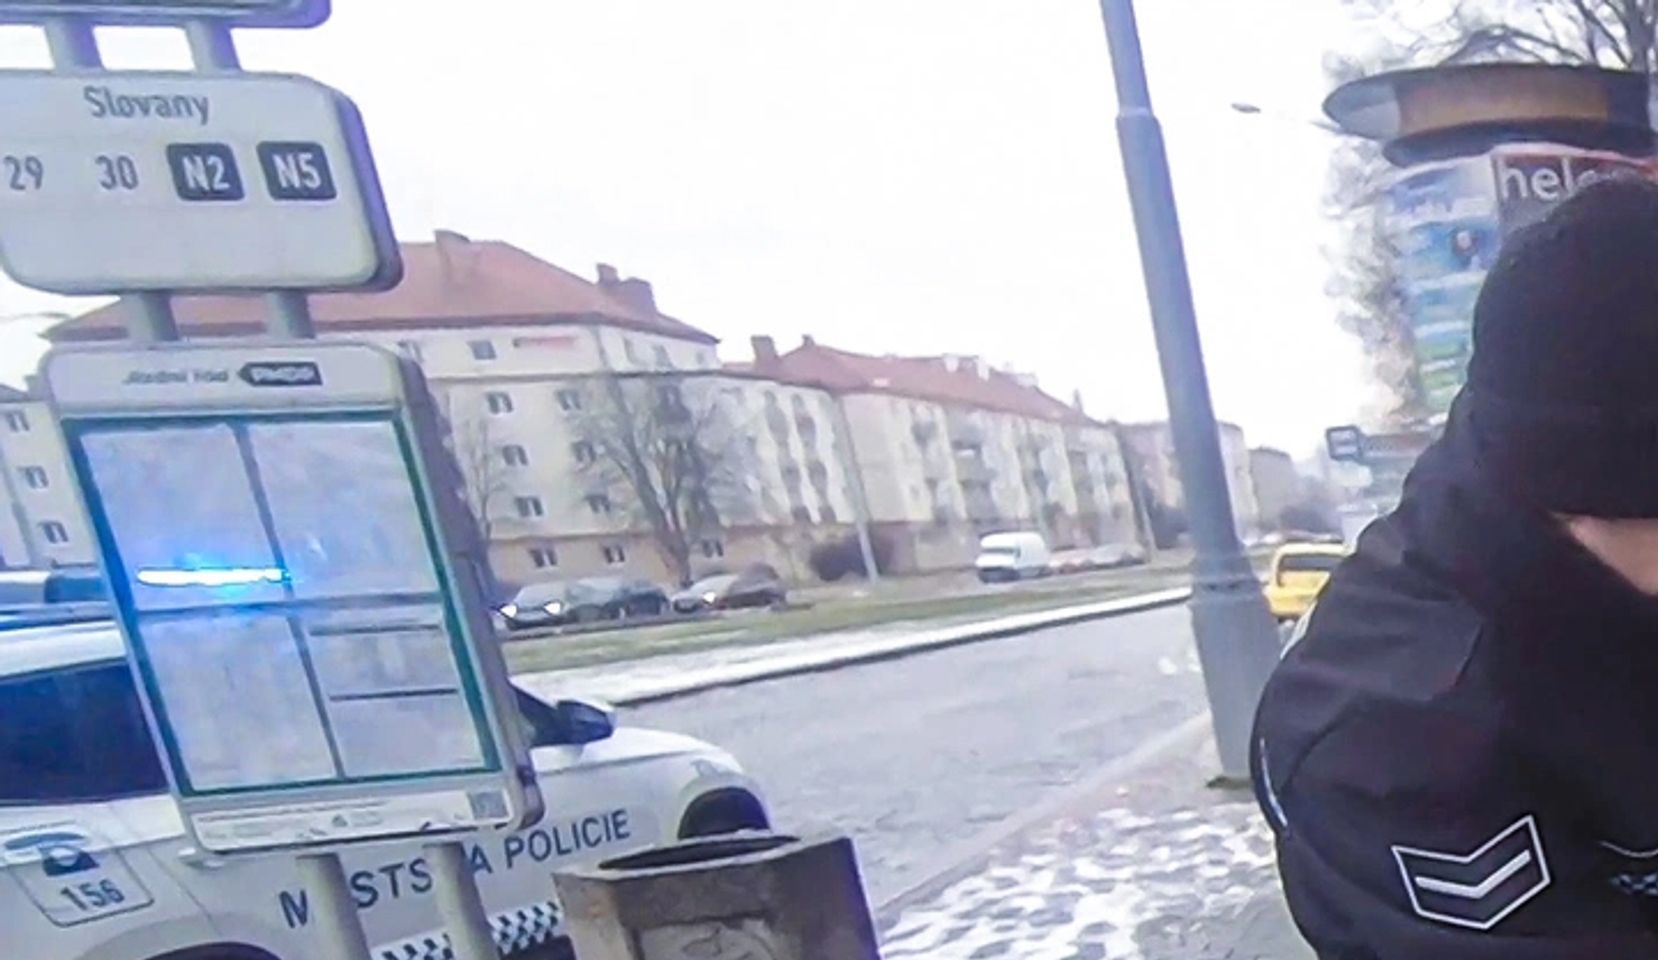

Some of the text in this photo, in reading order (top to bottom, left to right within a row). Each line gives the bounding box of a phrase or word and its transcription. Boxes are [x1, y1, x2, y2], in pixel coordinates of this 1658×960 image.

[84, 86, 210, 126] Slovany
[4, 155, 322, 191] 29 30 N2 N5
[504, 809, 631, 869] POLICIE
[60, 878, 125, 911] 156
